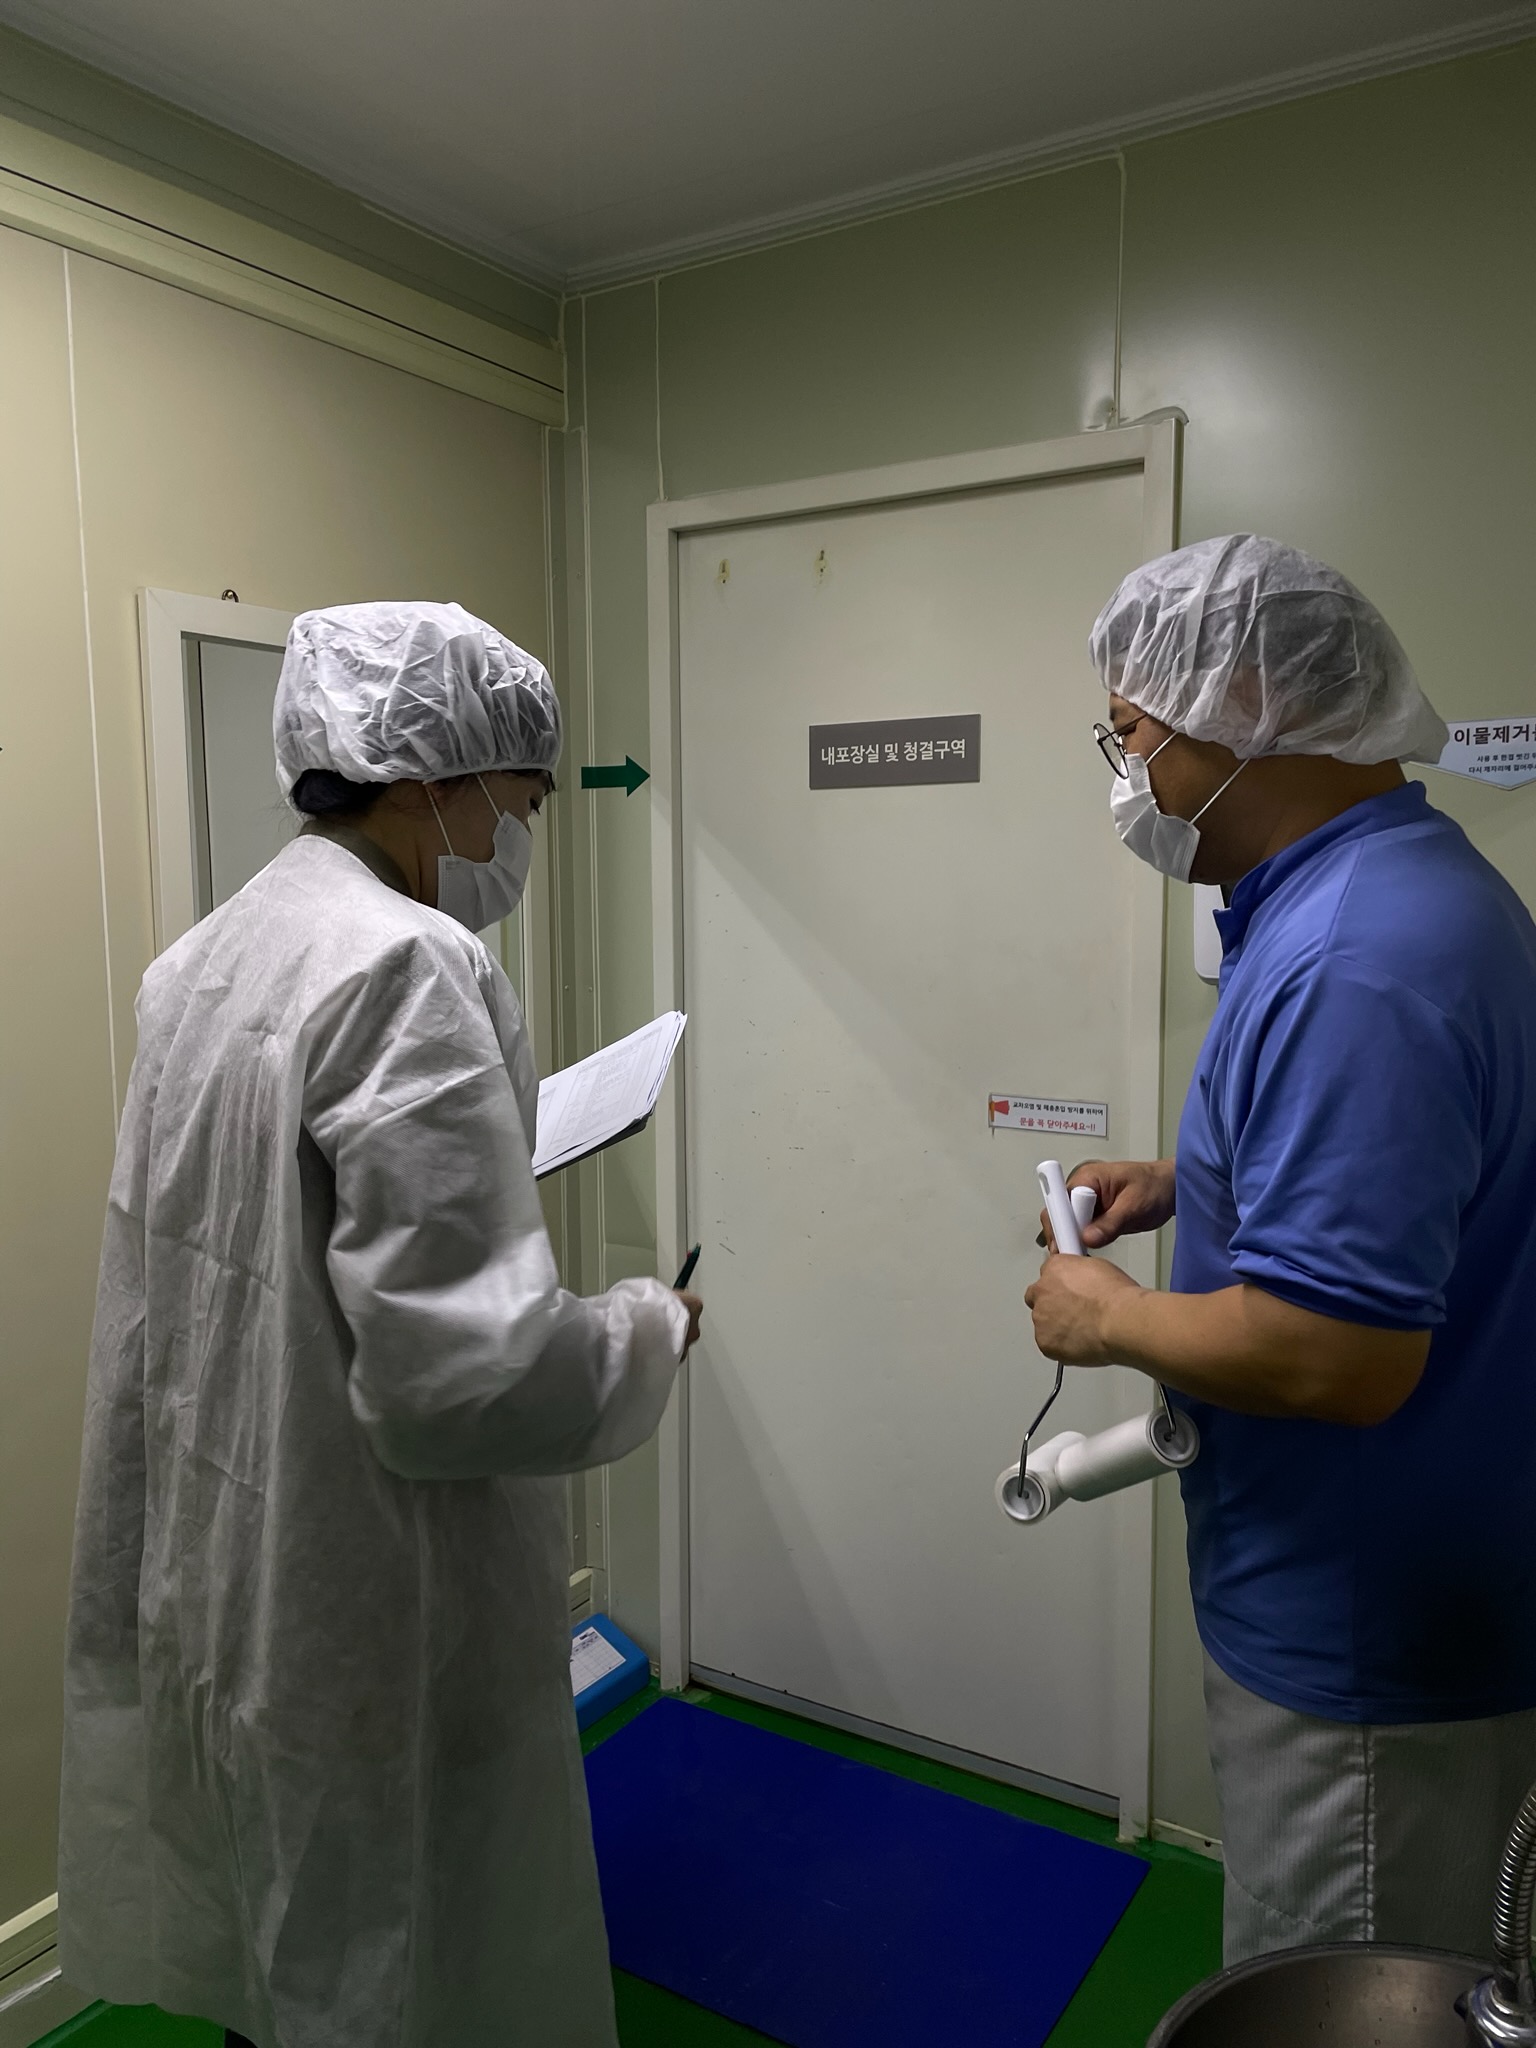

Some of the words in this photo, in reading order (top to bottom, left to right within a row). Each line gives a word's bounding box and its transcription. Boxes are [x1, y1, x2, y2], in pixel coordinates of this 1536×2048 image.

[1454, 724, 1536, 746] 이물제거
[821, 744, 879, 765] 내포장실
[884, 742, 899, 762] 및
[903, 739, 966, 761] 청결구역
[1013, 1101, 1035, 1110] 교차오염
[1036, 1103, 1042, 1111] 및
[1067, 1106, 1085, 1115] 방지를
[1020, 1117, 1034, 1127] 문을
[1037, 1118, 1045, 1128] 꼭
